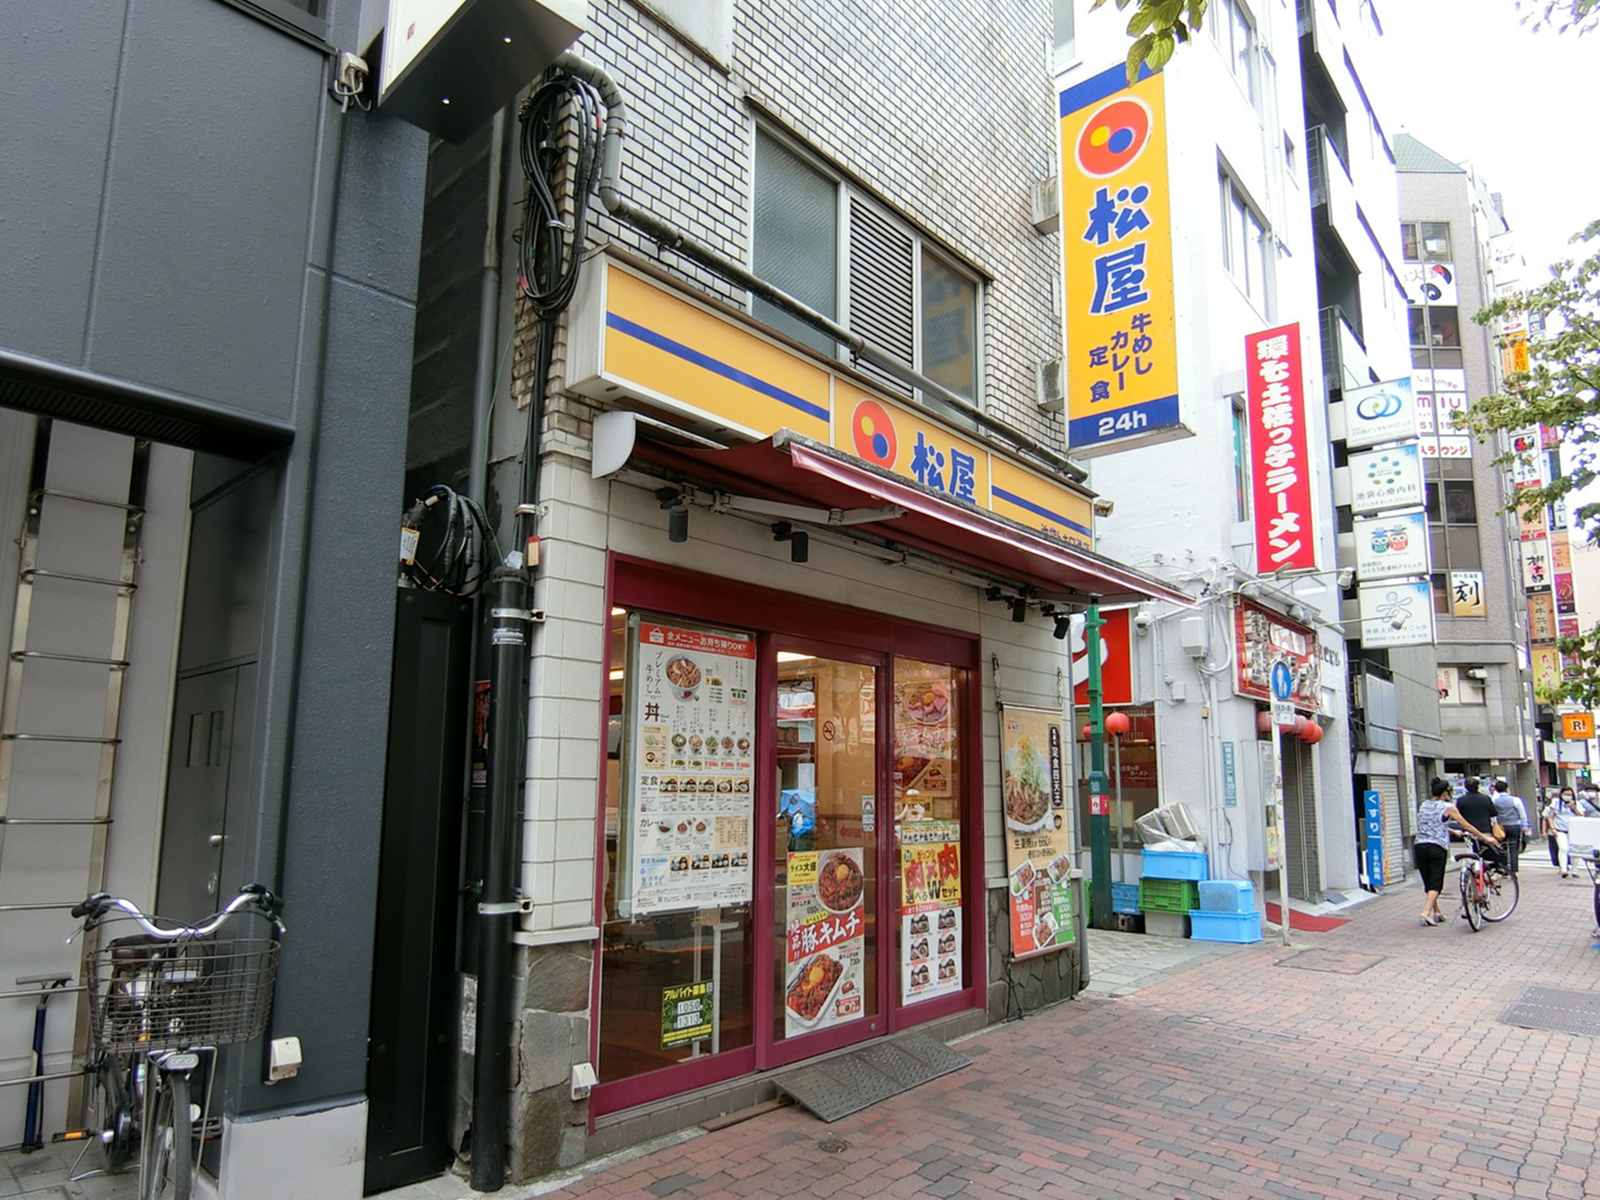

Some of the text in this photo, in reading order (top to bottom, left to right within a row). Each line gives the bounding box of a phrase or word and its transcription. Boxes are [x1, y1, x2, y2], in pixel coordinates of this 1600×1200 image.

[1082, 184, 1151, 316] 松屋
[1111, 330, 1130, 391] カレー
[1130, 313, 1153, 375] 牛めし
[1089, 346, 1110, 403] 定食
[1098, 412, 1148, 438] 24h
[910, 431, 977, 505] 松屋
[1453, 580, 1480, 607] 刻
[646, 663, 654, 694] 牛めし
[645, 702, 660, 722] 丼
[641, 775, 658, 786] 定食
[801, 911, 861, 953] 豚キムチ
